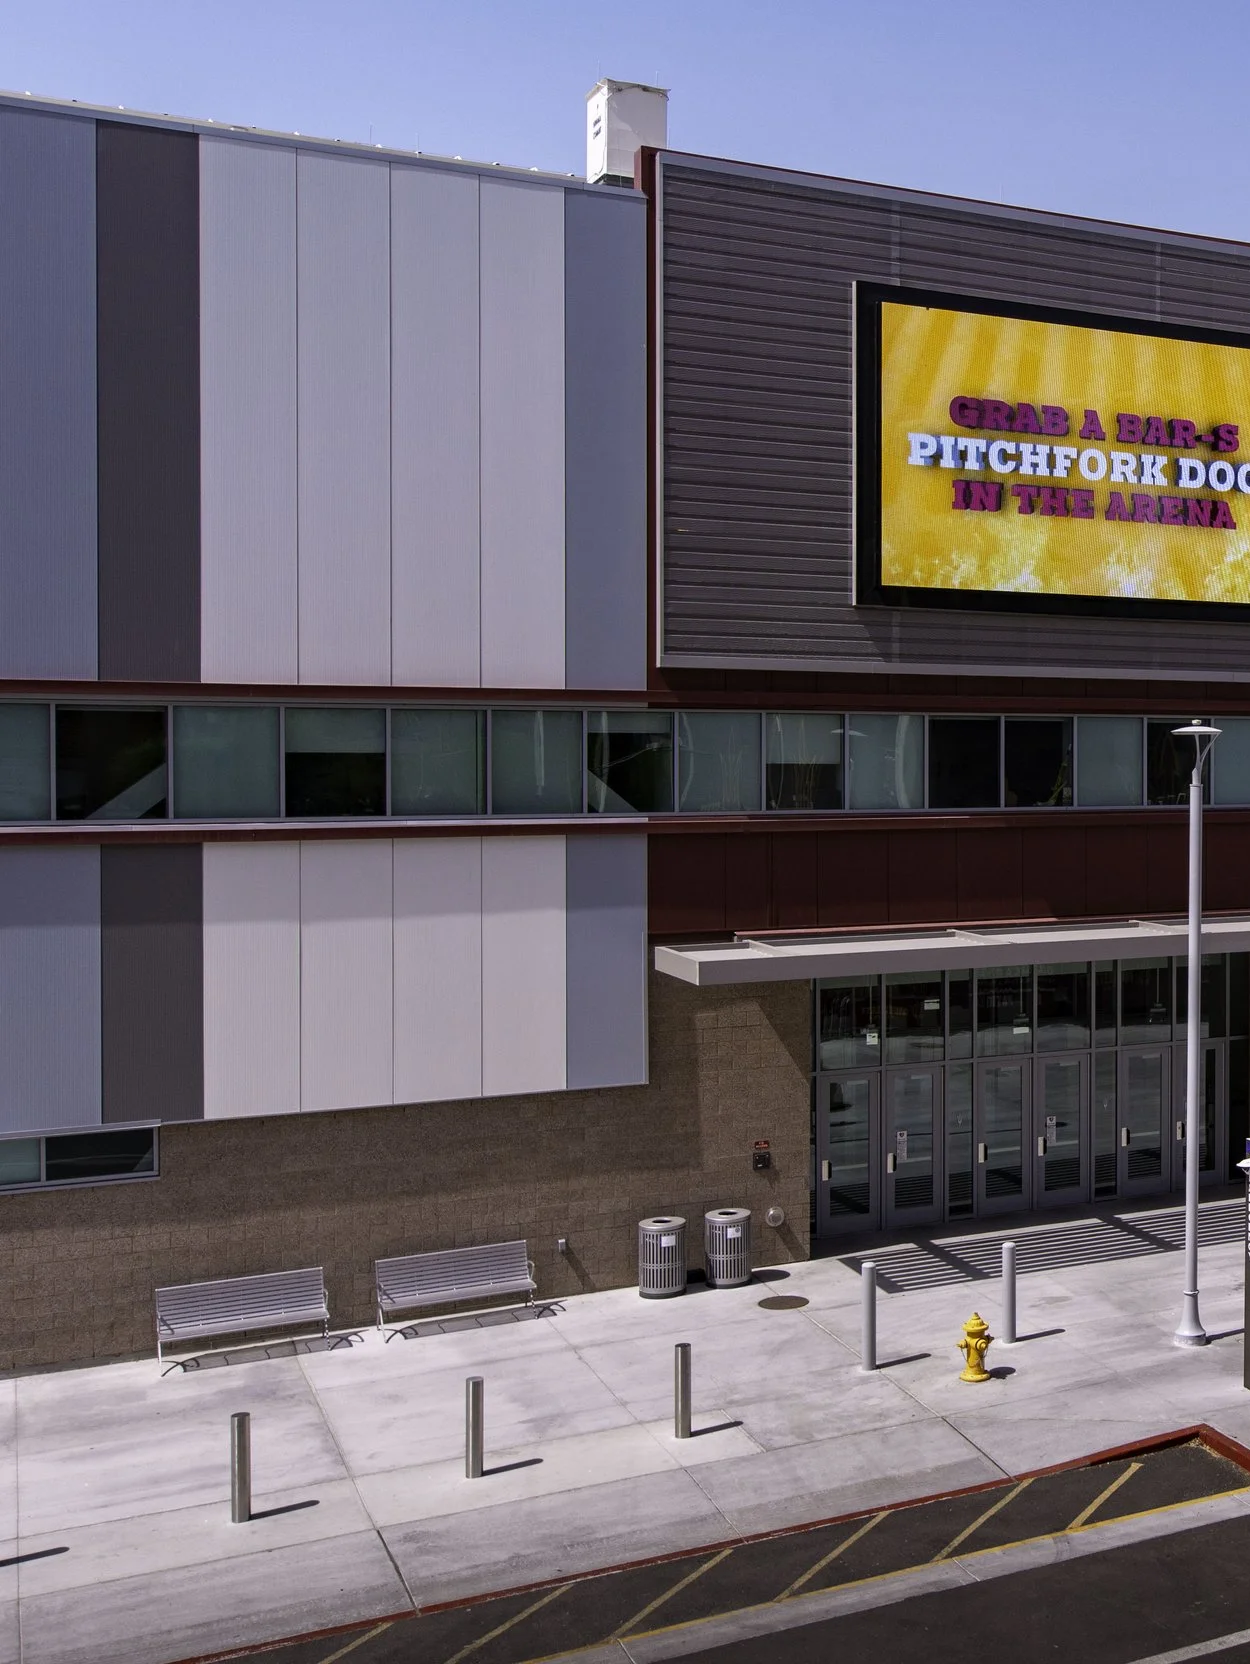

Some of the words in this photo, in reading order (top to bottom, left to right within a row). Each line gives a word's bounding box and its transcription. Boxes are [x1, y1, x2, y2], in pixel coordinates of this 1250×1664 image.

[949, 396, 1069, 436] GRAB
[1079, 410, 1106, 441] A
[1116, 413, 1240, 453] BAR-S
[907, 432, 1168, 487] PITCHFORK
[952, 480, 1002, 513] IN
[1012, 484, 1094, 520] THE
[1105, 491, 1237, 530] ARENA
